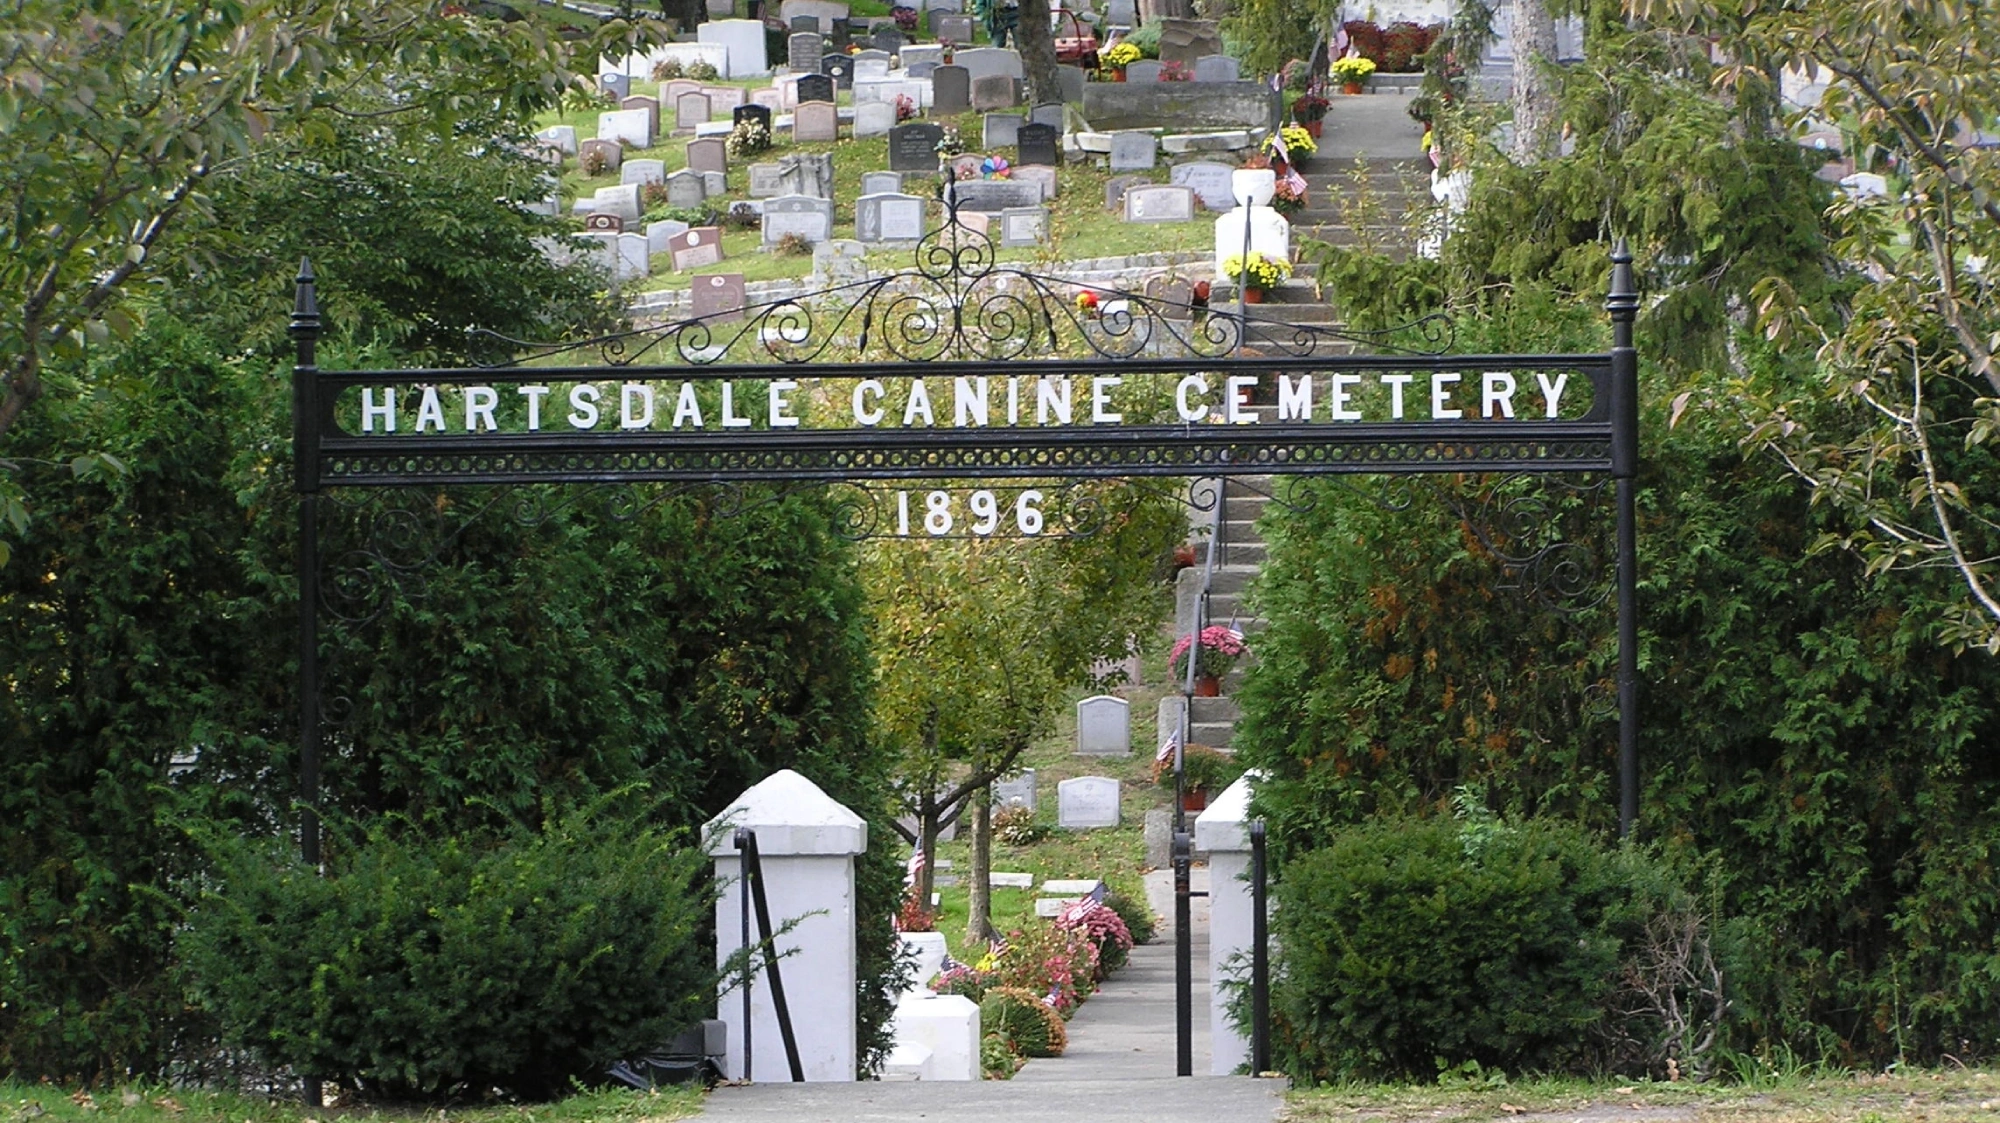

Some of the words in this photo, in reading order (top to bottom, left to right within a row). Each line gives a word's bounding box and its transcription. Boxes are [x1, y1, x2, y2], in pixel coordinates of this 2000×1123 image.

[361, 379, 800, 432] HARTSDALE
[851, 374, 1124, 427] CANINE
[1173, 371, 1568, 424] CEMETERY
[896, 489, 1044, 536] 1896
